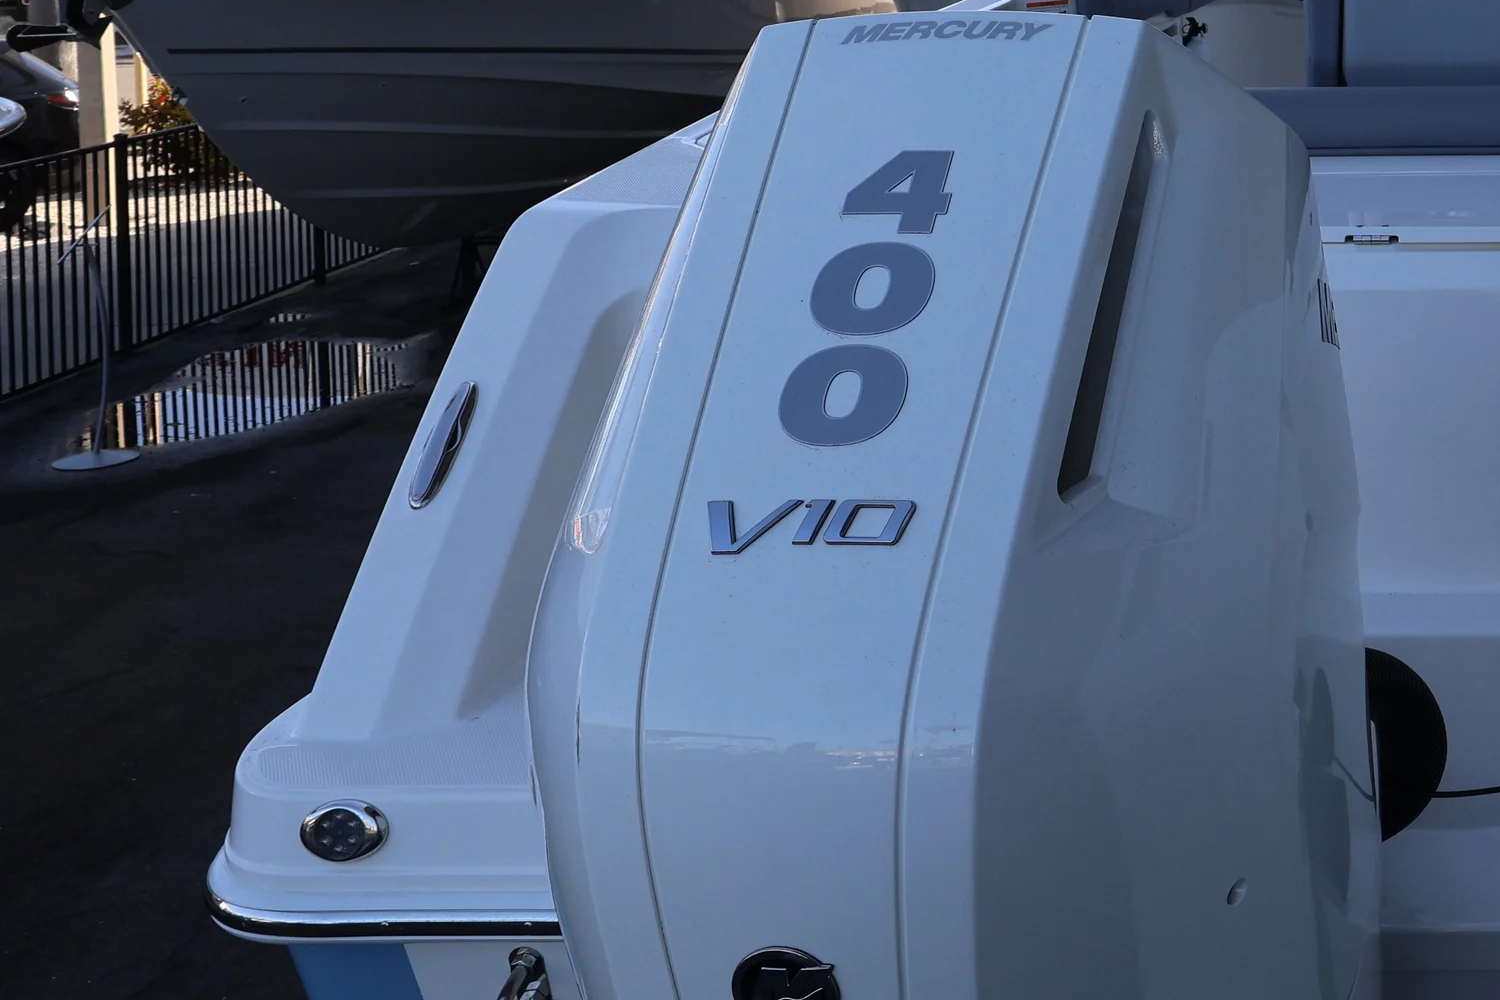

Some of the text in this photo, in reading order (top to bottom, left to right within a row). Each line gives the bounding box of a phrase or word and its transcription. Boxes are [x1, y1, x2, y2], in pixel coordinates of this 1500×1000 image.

[840, 20, 1055, 45] MERCURY
[778, 150, 955, 447] 400
[707, 499, 917, 556] V10
